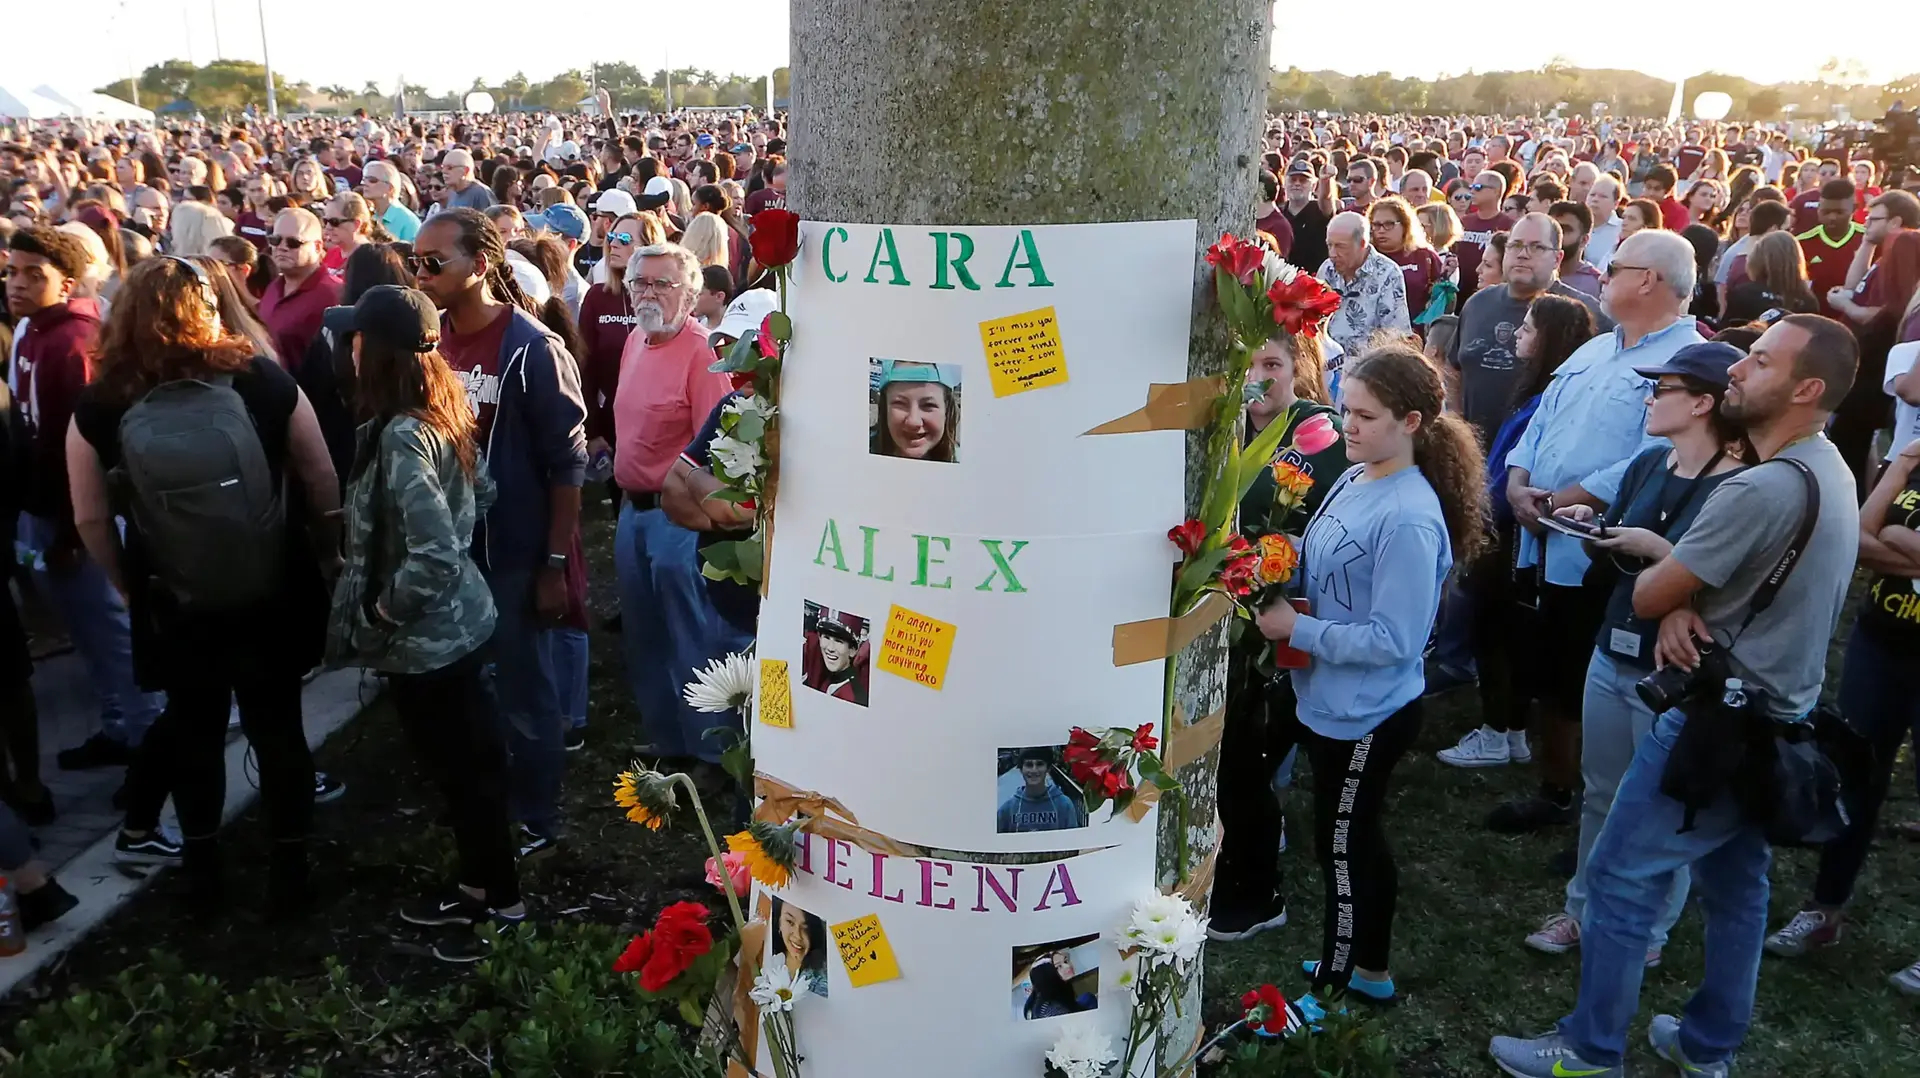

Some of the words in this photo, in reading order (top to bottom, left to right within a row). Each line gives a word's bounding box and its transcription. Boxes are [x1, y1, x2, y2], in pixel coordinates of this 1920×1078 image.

[822, 227, 1054, 291] CARA
[988, 326, 1006, 336] I'll
[1011, 321, 1034, 330] miss
[1038, 317, 1053, 327] you
[988, 336, 1022, 348] forever
[1028, 331, 1046, 341] and
[993, 350, 1007, 358] all
[1028, 354, 1035, 362] I
[813, 518, 1029, 593] ALEX
[1770, 550, 1796, 584] Canon
[895, 610, 906, 621] hi
[907, 617, 933, 633] angel
[885, 639, 905, 652] more
[906, 646, 926, 659] than
[897, 629, 917, 643] miss
[919, 637, 935, 648] you
[1348, 733, 1373, 772] PINK
[1338, 778, 1360, 813] PINK
[1333, 819, 1350, 853] PINK
[1334, 860, 1352, 896] PINK
[1336, 902, 1353, 938] PINK
[1331, 942, 1351, 972] PINK
